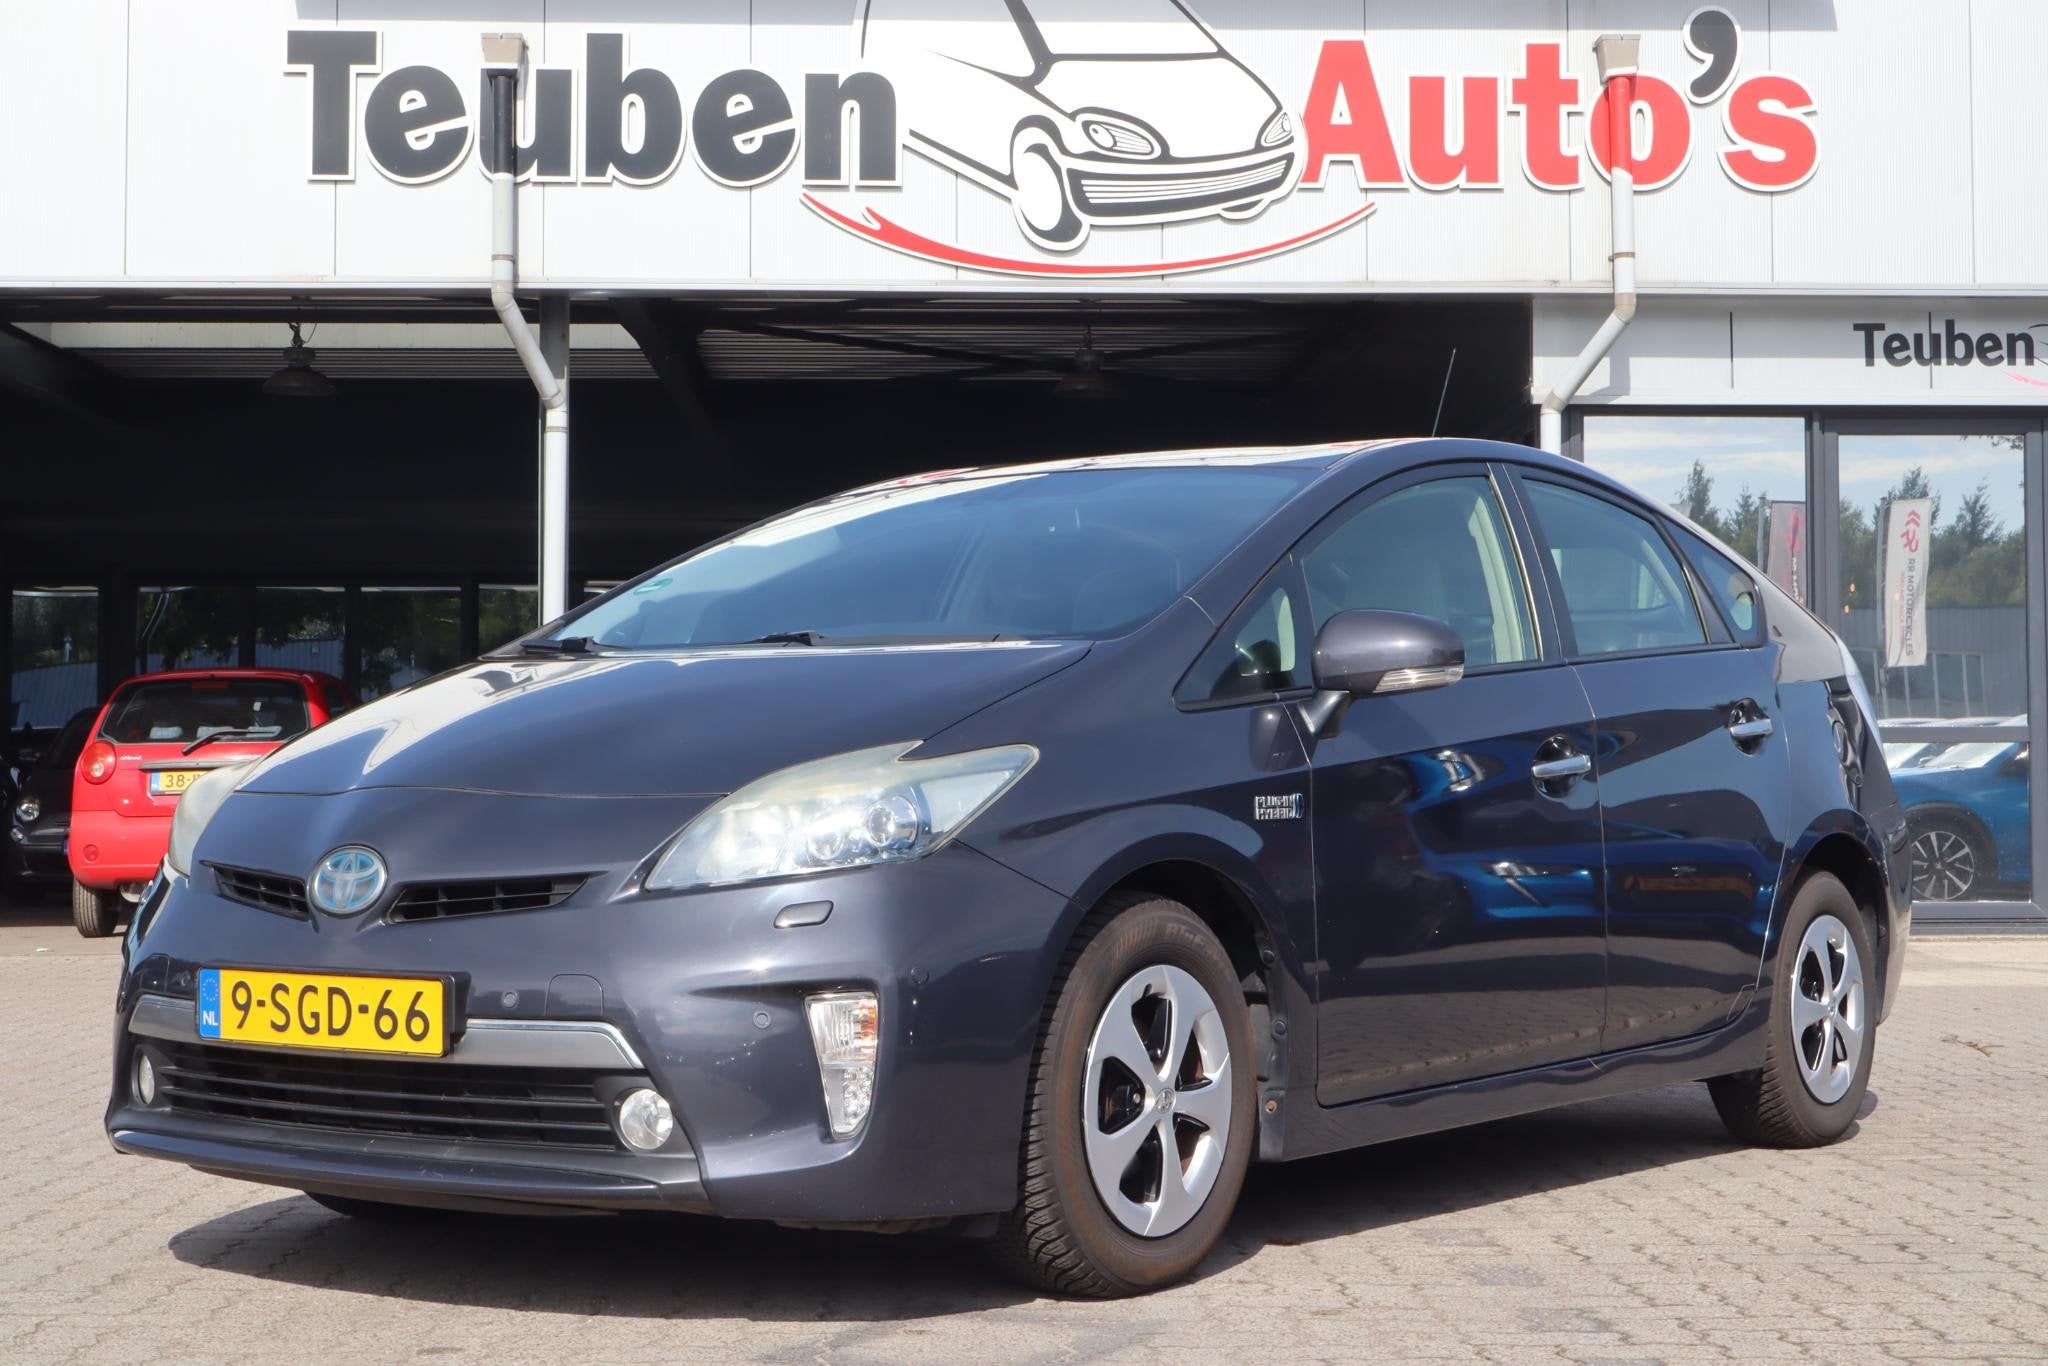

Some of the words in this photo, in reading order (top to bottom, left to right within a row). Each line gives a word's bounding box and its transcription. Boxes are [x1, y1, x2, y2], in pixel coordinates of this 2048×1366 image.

[286, 30, 898, 181] Teuben
[1300, 10, 1817, 187] Auto's
[1853, 319, 2035, 367] Teuben
[1904, 575, 1916, 657] MOTORCYCLES
[203, 1010, 218, 1026] NL
[231, 980, 430, 1042] 9-SGD-66
